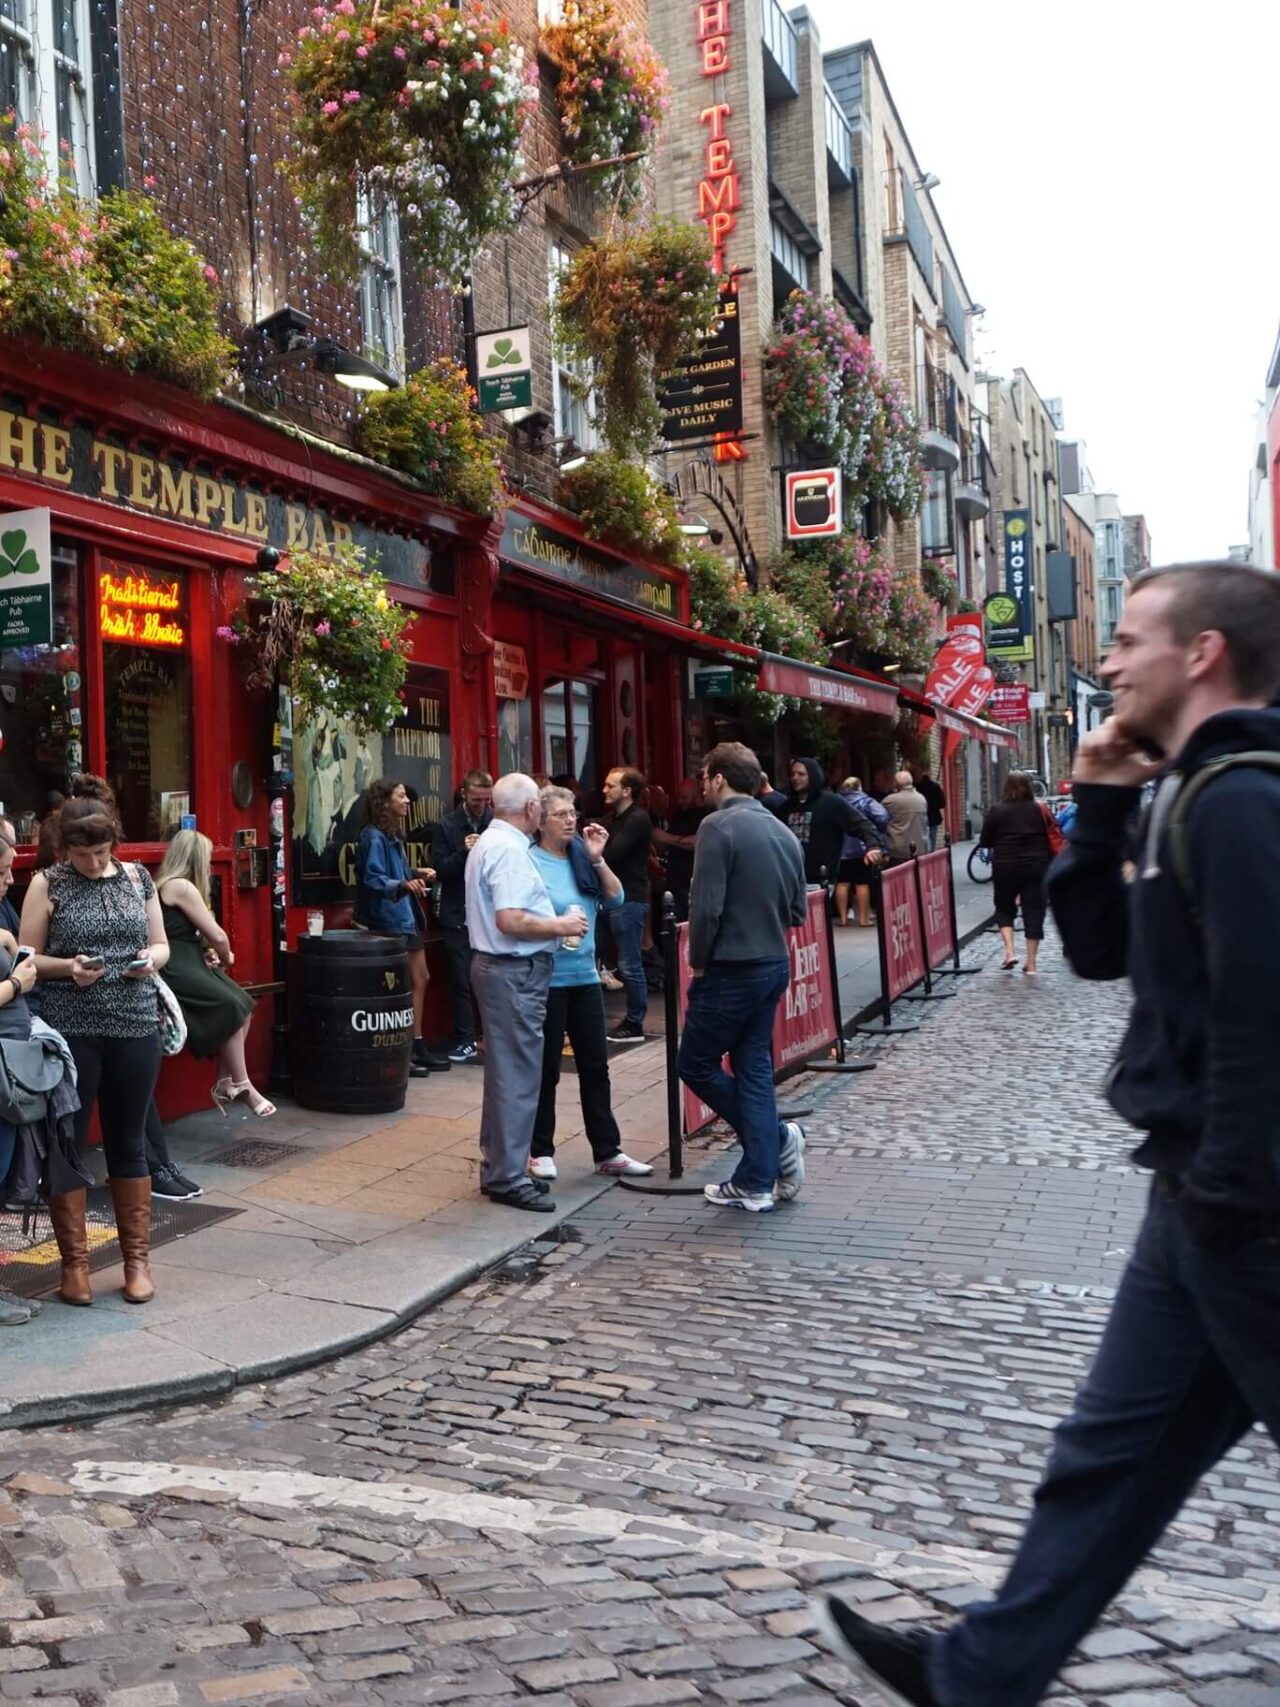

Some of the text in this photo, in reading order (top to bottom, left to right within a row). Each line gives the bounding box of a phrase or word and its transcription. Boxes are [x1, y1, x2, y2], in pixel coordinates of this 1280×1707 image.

[690, 358, 736, 374] GARDEN
[694, 398, 734, 413] MUSIC
[680, 413, 717, 426] DAILY
[93, 440, 270, 540] TEMPLE
[285, 503, 354, 564] BAR
[100, 574, 179, 608] Traditional
[9, 606, 23, 616] Pub
[419, 697, 440, 726] THE
[394, 727, 440, 760] EMPEROR
[429, 765, 441, 791] OF
[351, 1008, 414, 1032] GUINNES
